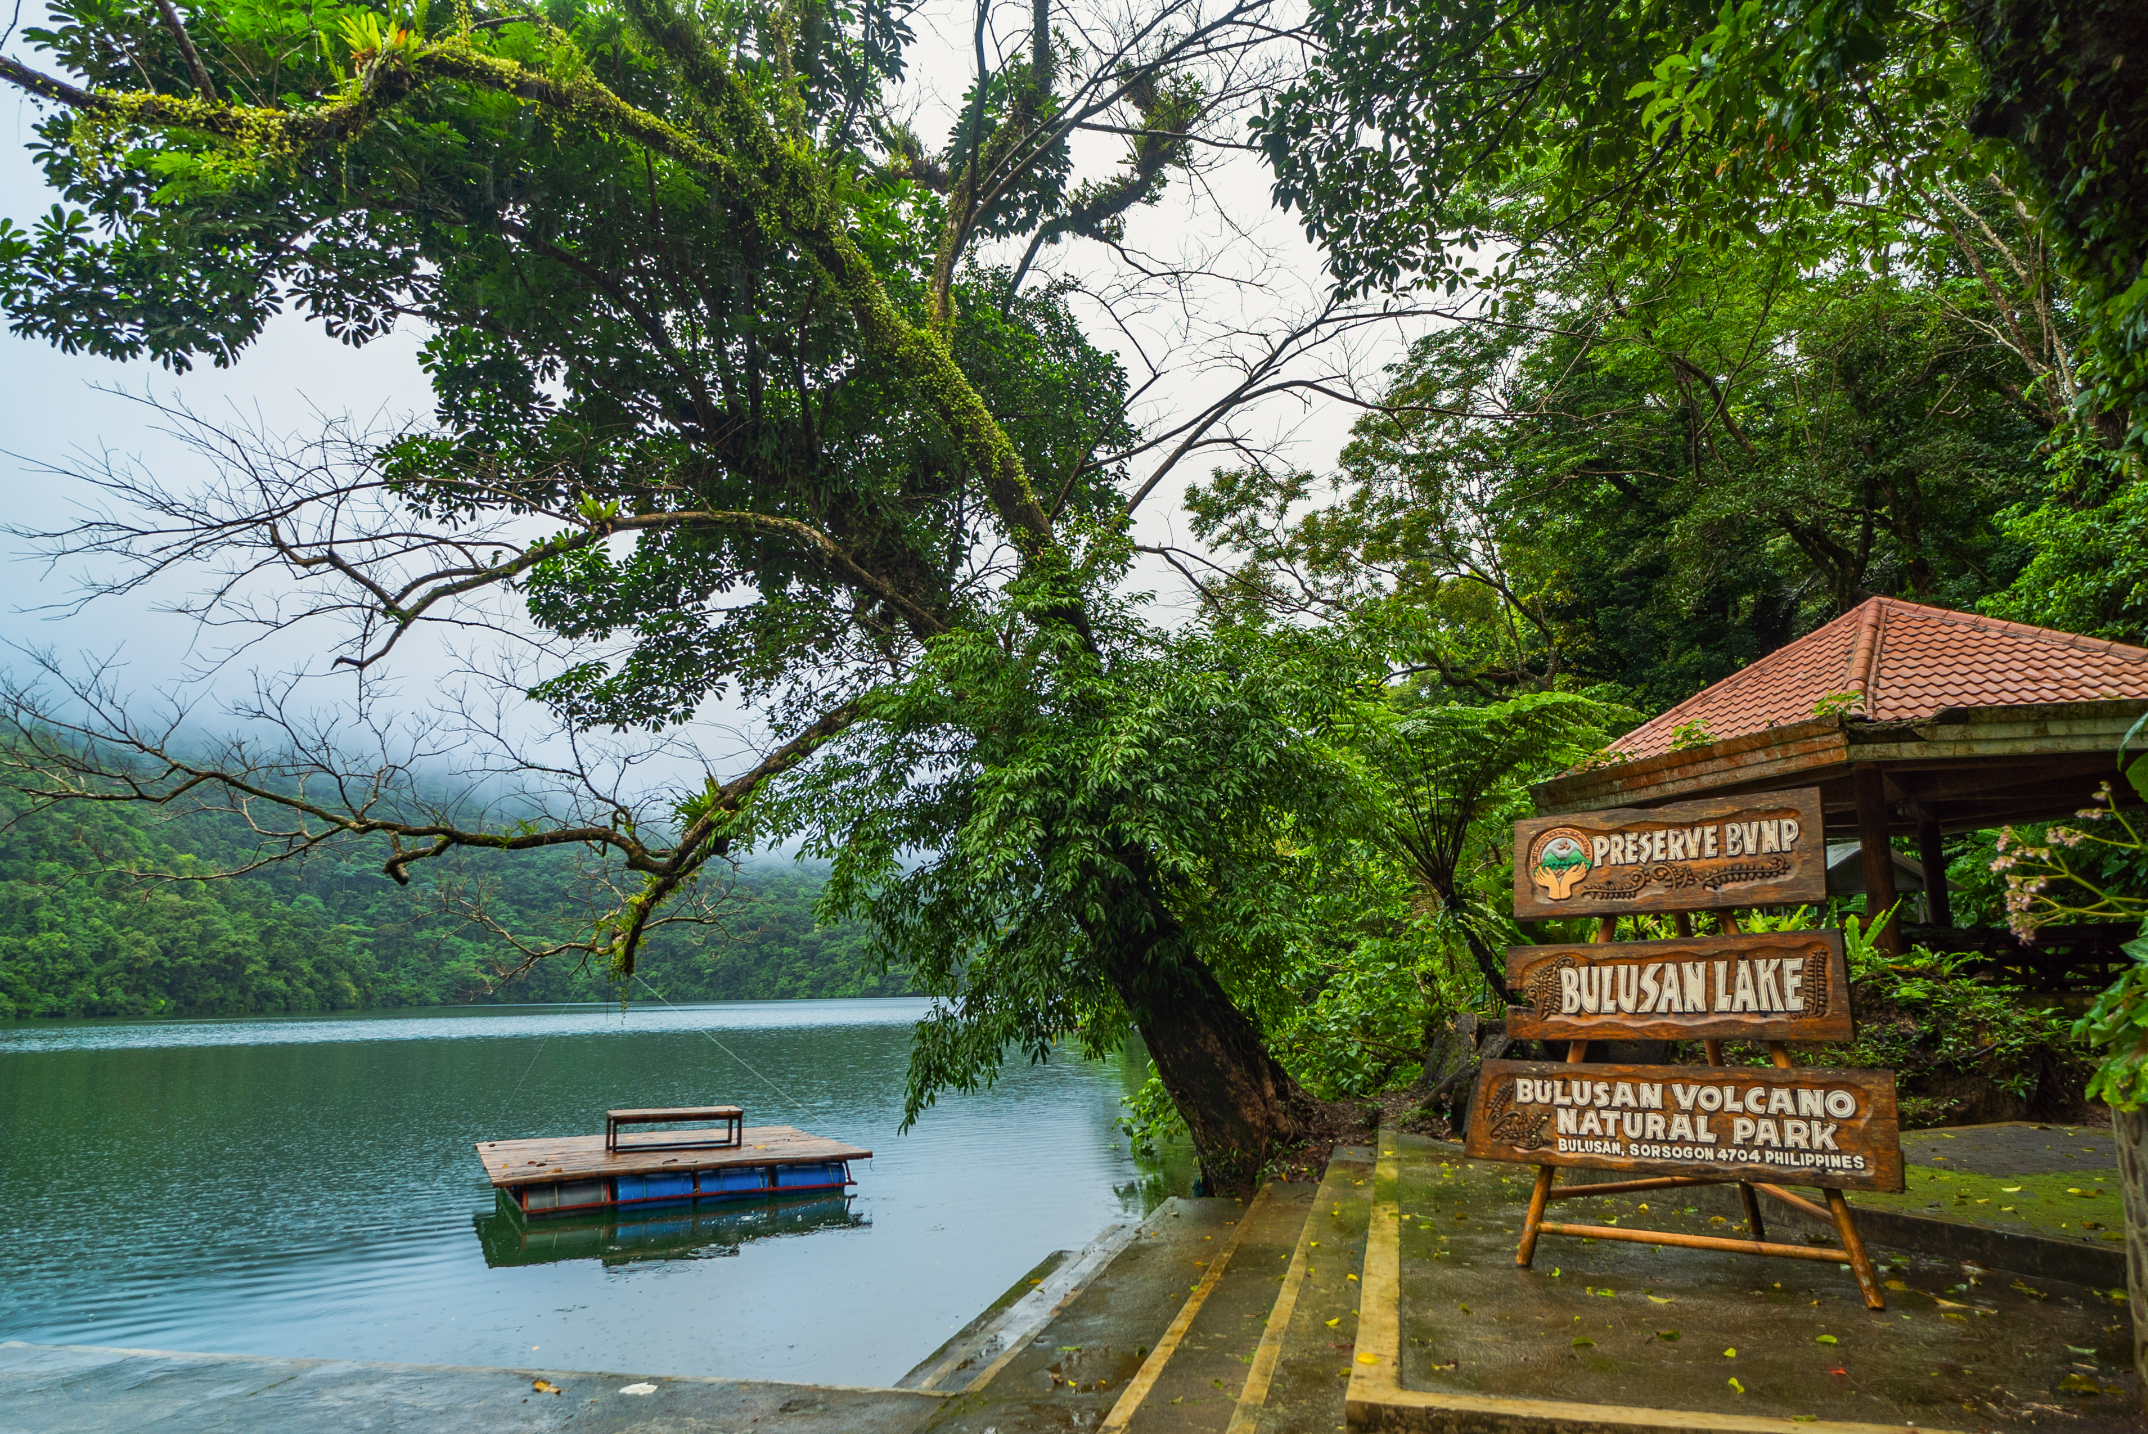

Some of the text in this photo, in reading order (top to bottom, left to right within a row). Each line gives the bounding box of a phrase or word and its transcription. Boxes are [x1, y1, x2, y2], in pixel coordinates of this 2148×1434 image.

[1592, 824, 1718, 867] PRESERVE
[1725, 818, 1798, 856] BVNP
[1559, 957, 1804, 1014] BULUSAN LAKE
[1515, 1078, 1857, 1119] BULUSAN VOLCANO
[1556, 1108, 1840, 1151] NATURAL PARK
[1558, 1138, 1866, 1170] BULUSAN, SORSOGON 4704 PHILIPPINES
